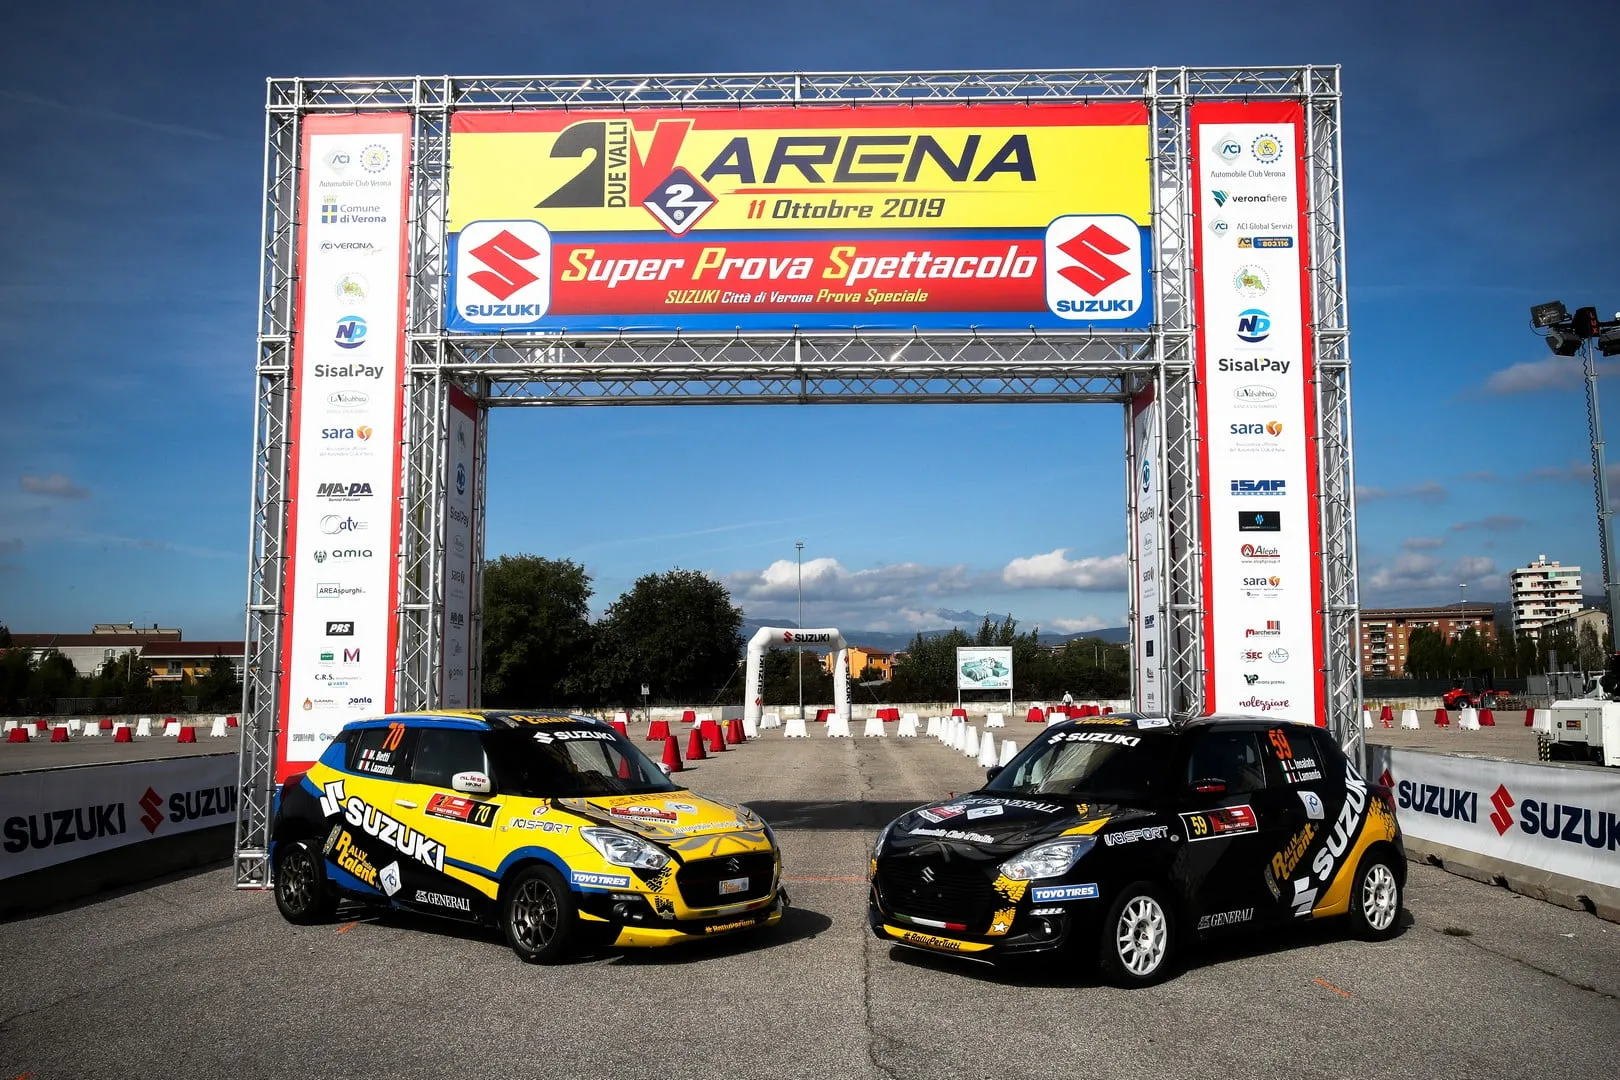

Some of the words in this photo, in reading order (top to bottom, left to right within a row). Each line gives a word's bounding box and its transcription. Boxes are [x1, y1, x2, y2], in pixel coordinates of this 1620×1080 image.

[608, 121, 628, 168] VALLI
[1223, 145, 1241, 154] ACI
[332, 155, 350, 164] ACI
[701, 134, 1036, 184] ARENA
[608, 172, 627, 208] DUE
[1232, 193, 1287, 202] veronafiere
[340, 204, 380, 212] Comune
[747, 200, 765, 219] 11
[772, 199, 873, 219] Ottobre
[880, 198, 945, 218] 2019
[340, 215, 349, 223] di
[351, 215, 386, 223] Verona
[561, 248, 684, 288] Super
[691, 246, 814, 281] Prova
[822, 245, 1038, 286] Spettacolo
[664, 289, 720, 304] SUZUKI
[721, 291, 751, 303] Città
[758, 291, 767, 303] di
[770, 292, 813, 303] Verona
[816, 288, 861, 303] Prova
[865, 288, 928, 304] Speciale
[465, 304, 540, 316] SUZUKI
[1056, 300, 1133, 312] SUZUKI
[314, 364, 384, 379] SisalPay
[1218, 358, 1290, 374] SisalPay
[321, 428, 354, 439] sara
[1230, 424, 1263, 434] sara
[340, 517, 358, 531] atv
[332, 549, 373, 557] amia
[1255, 545, 1278, 555] Aleph
[1243, 577, 1267, 585] sara
[329, 623, 351, 632] PRS
[794, 633, 830, 643] SUZUKI
[757, 655, 765, 695] SUZUKI
[1239, 696, 1289, 711] noleggiare
[382, 722, 405, 751] 70
[553, 731, 617, 742] SUZUKI
[1065, 732, 1141, 747] SUZUKI
[1268, 729, 1292, 760] 59
[1287, 760, 1295, 770] L.
[1292, 772, 1299, 782] L.
[168, 785, 250, 822] SUZUK
[979, 798, 1064, 813] GENERALI
[1398, 779, 1478, 824] SUZUKI
[475, 805, 491, 823] 70
[1312, 759, 1368, 881] SUZUKI
[3, 803, 126, 854] SUZUKI
[1190, 816, 1207, 835] 59
[345, 796, 446, 872] SUZUKI
[908, 828, 946, 836] Automobile
[946, 829, 962, 839] Club
[335, 830, 368, 861] RALLY
[337, 846, 377, 886] talent
[573, 875, 597, 884] TOYO
[598, 876, 628, 887] TIRES
[1036, 888, 1065, 899] TOYO
[1066, 886, 1094, 897] TIRES
[427, 892, 471, 911] GENERALI
[1211, 908, 1254, 927] GENERALI
[903, 932, 961, 951] #RallyPerTutti
